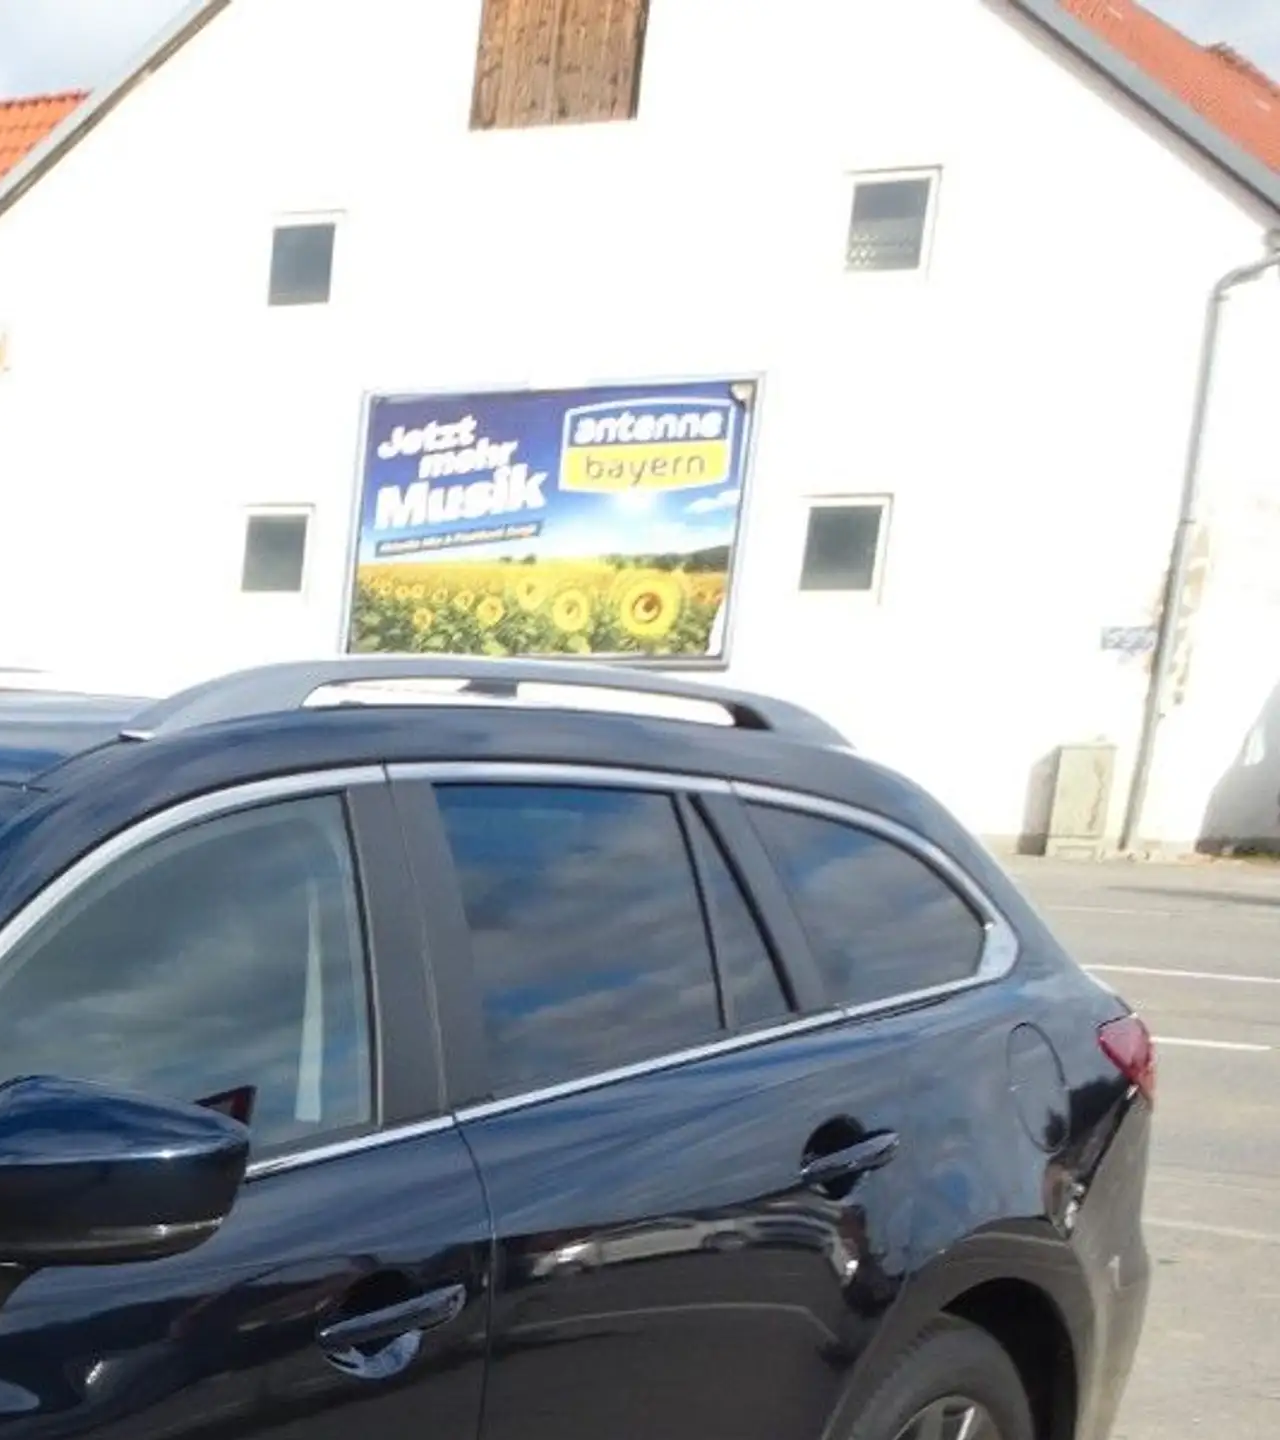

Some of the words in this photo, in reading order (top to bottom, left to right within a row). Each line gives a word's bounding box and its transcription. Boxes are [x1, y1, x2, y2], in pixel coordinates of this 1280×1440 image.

[377, 414, 478, 460] Jetzt
[574, 410, 723, 444] antenne
[419, 437, 519, 479] mehr
[586, 455, 705, 487] bayern
[374, 463, 548, 529] Musik
